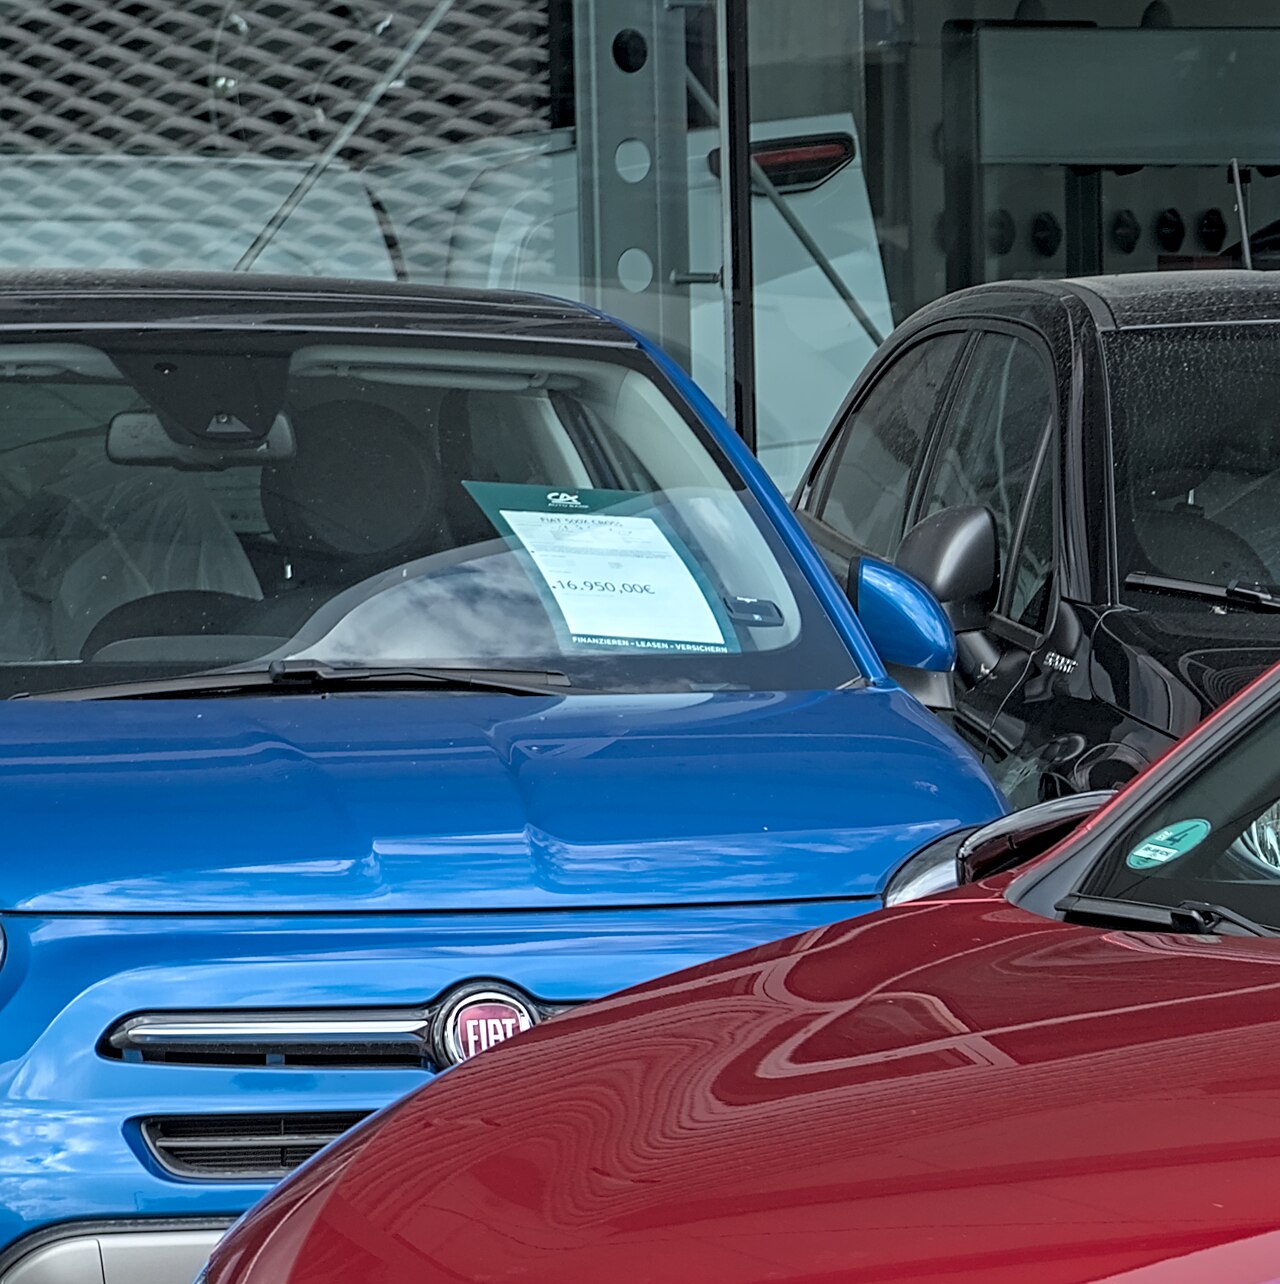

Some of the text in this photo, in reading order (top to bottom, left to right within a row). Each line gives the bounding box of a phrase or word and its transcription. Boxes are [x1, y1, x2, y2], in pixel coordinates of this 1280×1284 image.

[572, 636, 630, 647] FINANZIEREN
[636, 641, 669, 649] LEASEN
[675, 643, 728, 654] VERSICHERN
[466, 1018, 516, 1057] FIAT
